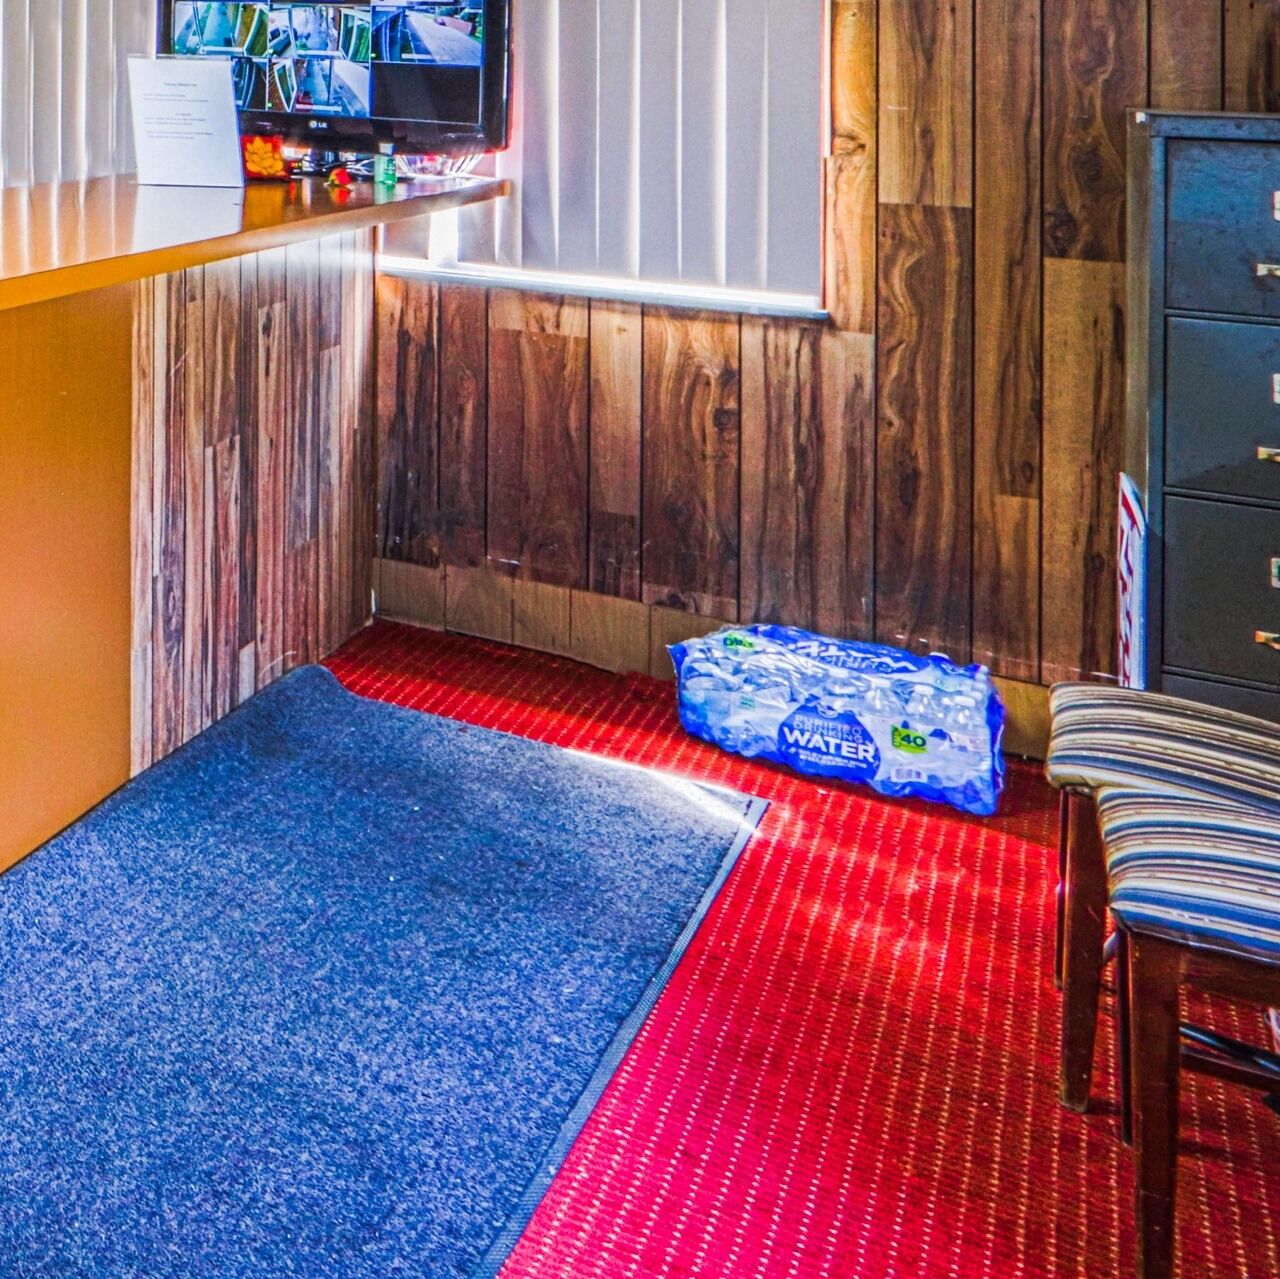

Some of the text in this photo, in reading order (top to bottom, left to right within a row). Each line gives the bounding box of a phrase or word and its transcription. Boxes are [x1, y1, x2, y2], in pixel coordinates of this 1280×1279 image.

[793, 721, 864, 743] DRINKING
[794, 714, 863, 735] PURIFIED
[783, 726, 876, 763] WATER
[901, 734, 927, 747] 40
